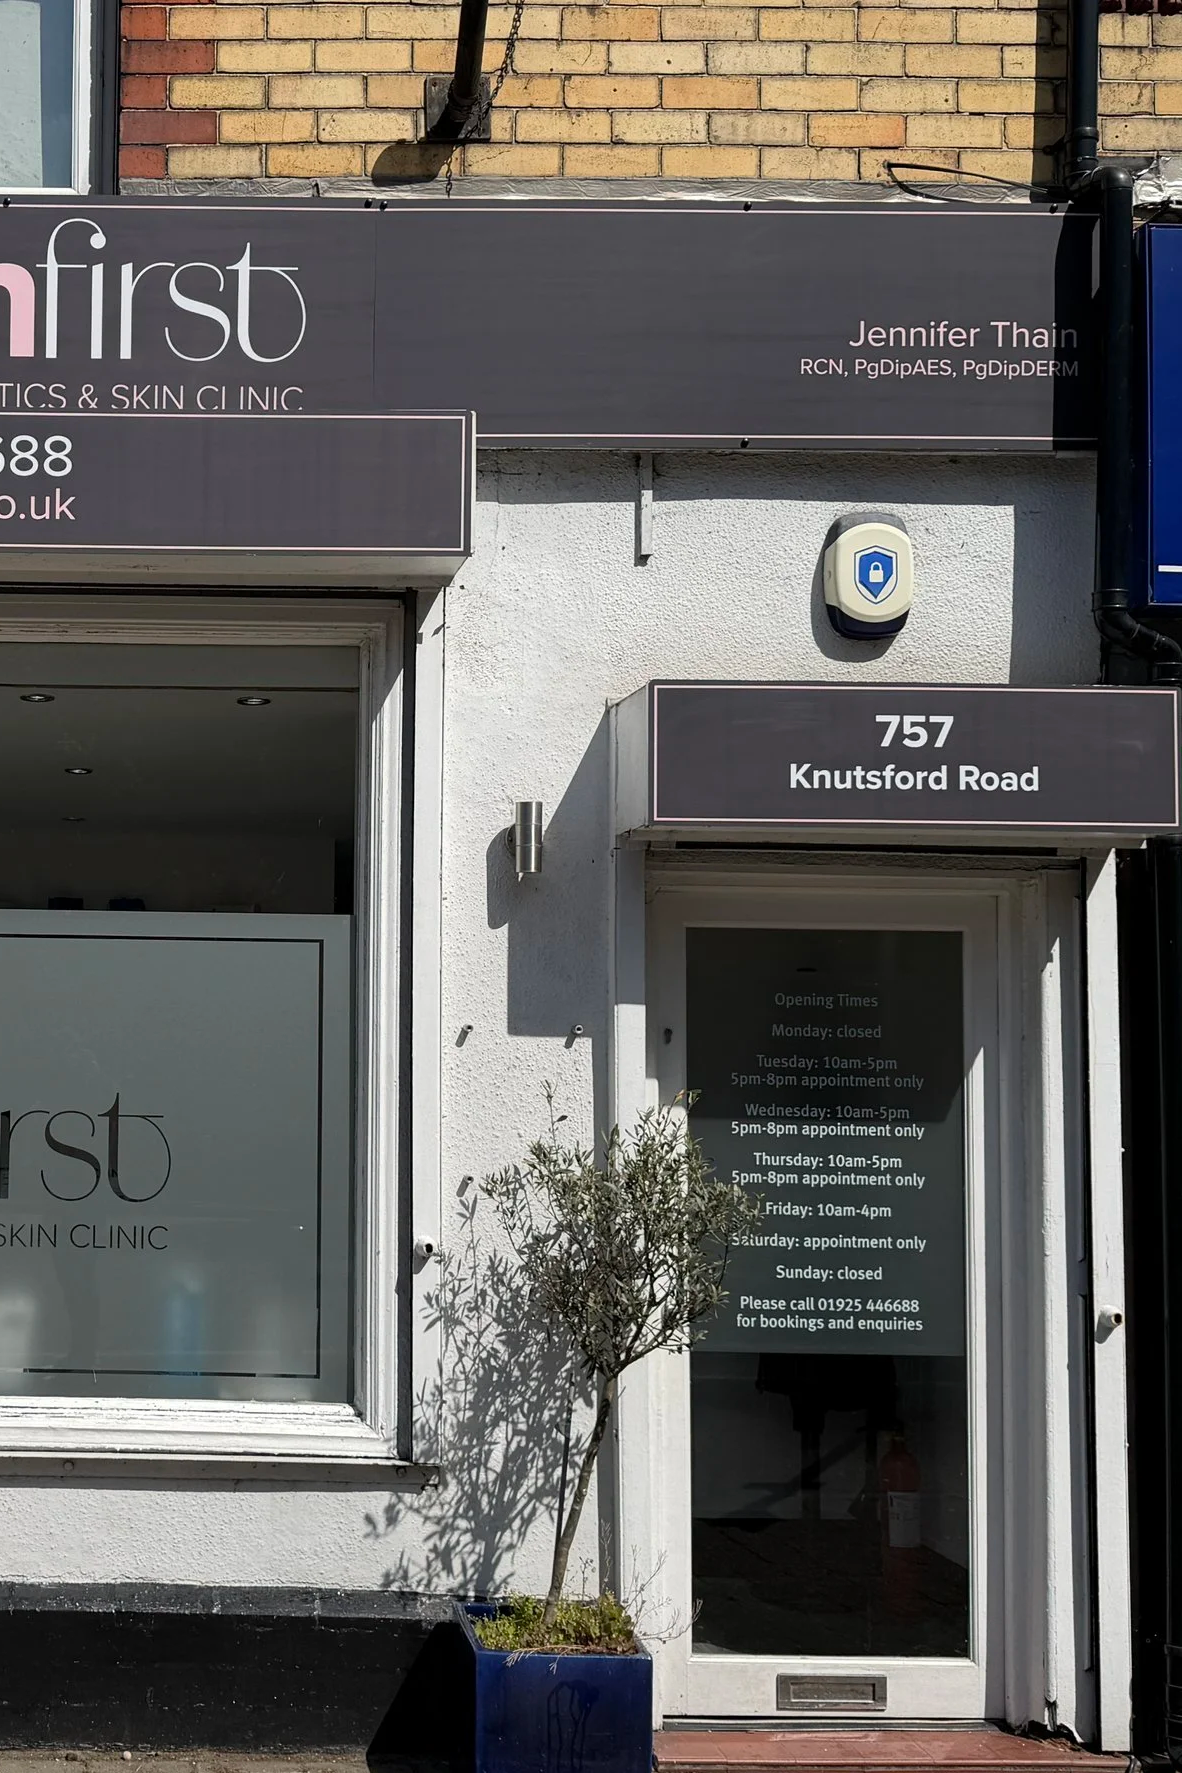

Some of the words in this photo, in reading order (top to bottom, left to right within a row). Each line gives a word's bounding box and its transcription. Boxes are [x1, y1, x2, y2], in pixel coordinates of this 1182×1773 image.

[849, 320, 979, 348] Jennifer
[990, 321, 1078, 349] Thain
[800, 358, 848, 377] RCN,
[854, 359, 957, 378] PgDipAES,
[963, 360, 1079, 380] PgDipDERM
[78, 384, 99, 409] &
[111, 385, 185, 410] SKIN
[875, 715, 954, 748] 757
[789, 763, 947, 791] Knutsford
[959, 765, 1039, 792] Road
[775, 992, 833, 1009] Opening
[838, 994, 878, 1008] Times
[772, 1024, 832, 1040] Monday:
[837, 1025, 881, 1038] closed
[756, 1054, 818, 1069] Tuesday:
[823, 1056, 897, 1072] 10am-5pm
[731, 1072, 797, 1088] 5pm-8pm
[802, 1074, 891, 1090] appointment
[894, 1074, 924, 1090] only
[745, 1103, 830, 1119] Wednesday:
[835, 1105, 910, 1122] 10am-5pm
[731, 1122, 798, 1138] 5pm-8pm
[802, 1123, 891, 1138] appointment
[895, 1124, 925, 1140] only
[754, 1152, 824, 1168] Thursday:
[828, 1154, 902, 1171] 10am-5pm
[732, 1170, 798, 1187] 5pm-8pm
[802, 1172, 892, 1188] appointment
[895, 1173, 925, 1188] only
[765, 1202, 813, 1218] Friday:
[817, 1203, 892, 1220] 10am-4pm
[70, 1223, 170, 1250] CLINIC
[731, 1233, 800, 1248] Saturday:
[804, 1235, 893, 1250] appointment
[896, 1236, 926, 1252] only
[776, 1266, 834, 1282] Sunday:
[837, 1266, 883, 1280] closed
[740, 1296, 786, 1310] Please
[790, 1297, 815, 1311] call
[818, 1298, 862, 1312] 01925
[866, 1300, 920, 1312] 446688
[736, 1314, 757, 1327] for
[760, 1314, 824, 1331] bookings
[828, 1316, 854, 1330] and
[858, 1317, 923, 1332] enquiries
